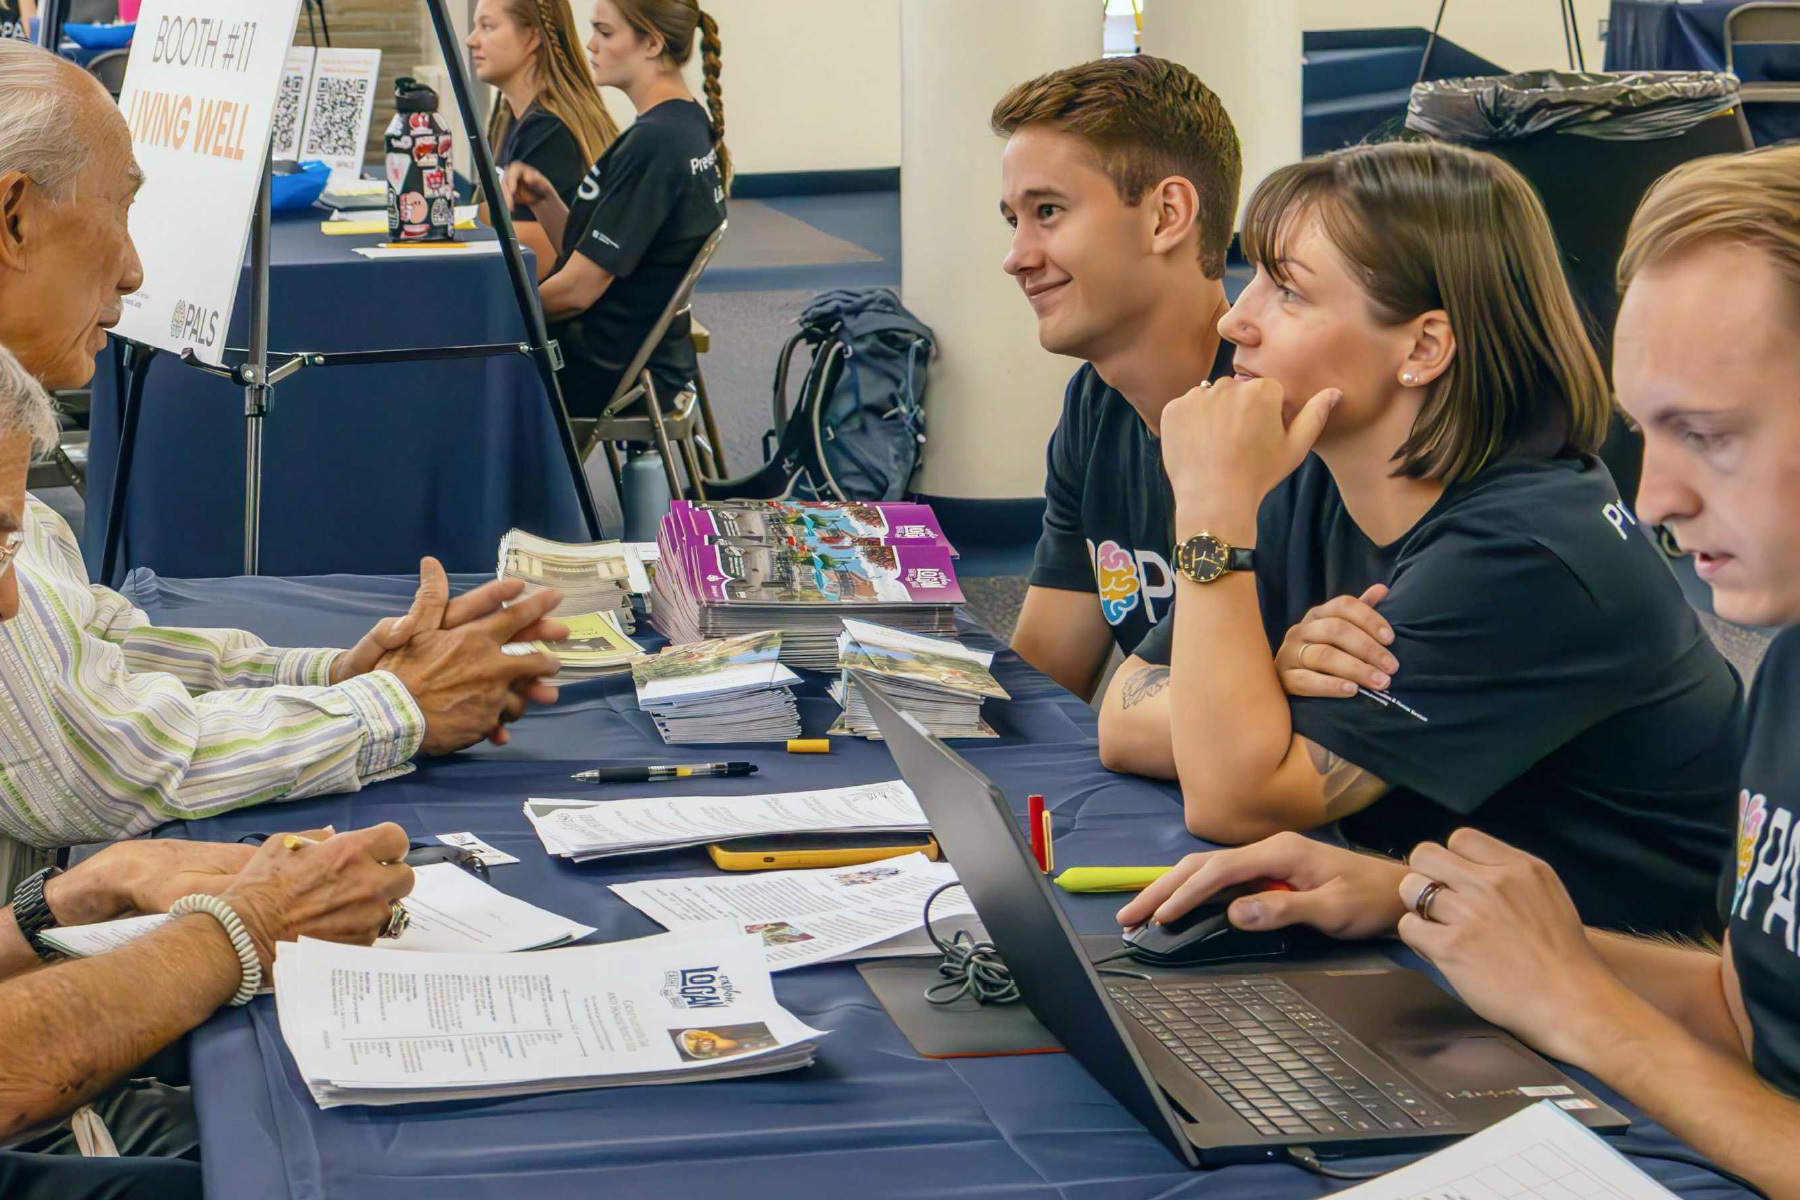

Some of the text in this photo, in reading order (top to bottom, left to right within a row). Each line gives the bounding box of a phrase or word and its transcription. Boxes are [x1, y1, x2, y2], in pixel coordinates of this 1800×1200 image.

[152, 15, 257, 73] BOOTH #11
[128, 89, 251, 161] LIVING WELL
[181, 303, 220, 347] PALS
[1740, 807, 1800, 957] PA
[679, 965, 730, 1009] LOGAN
